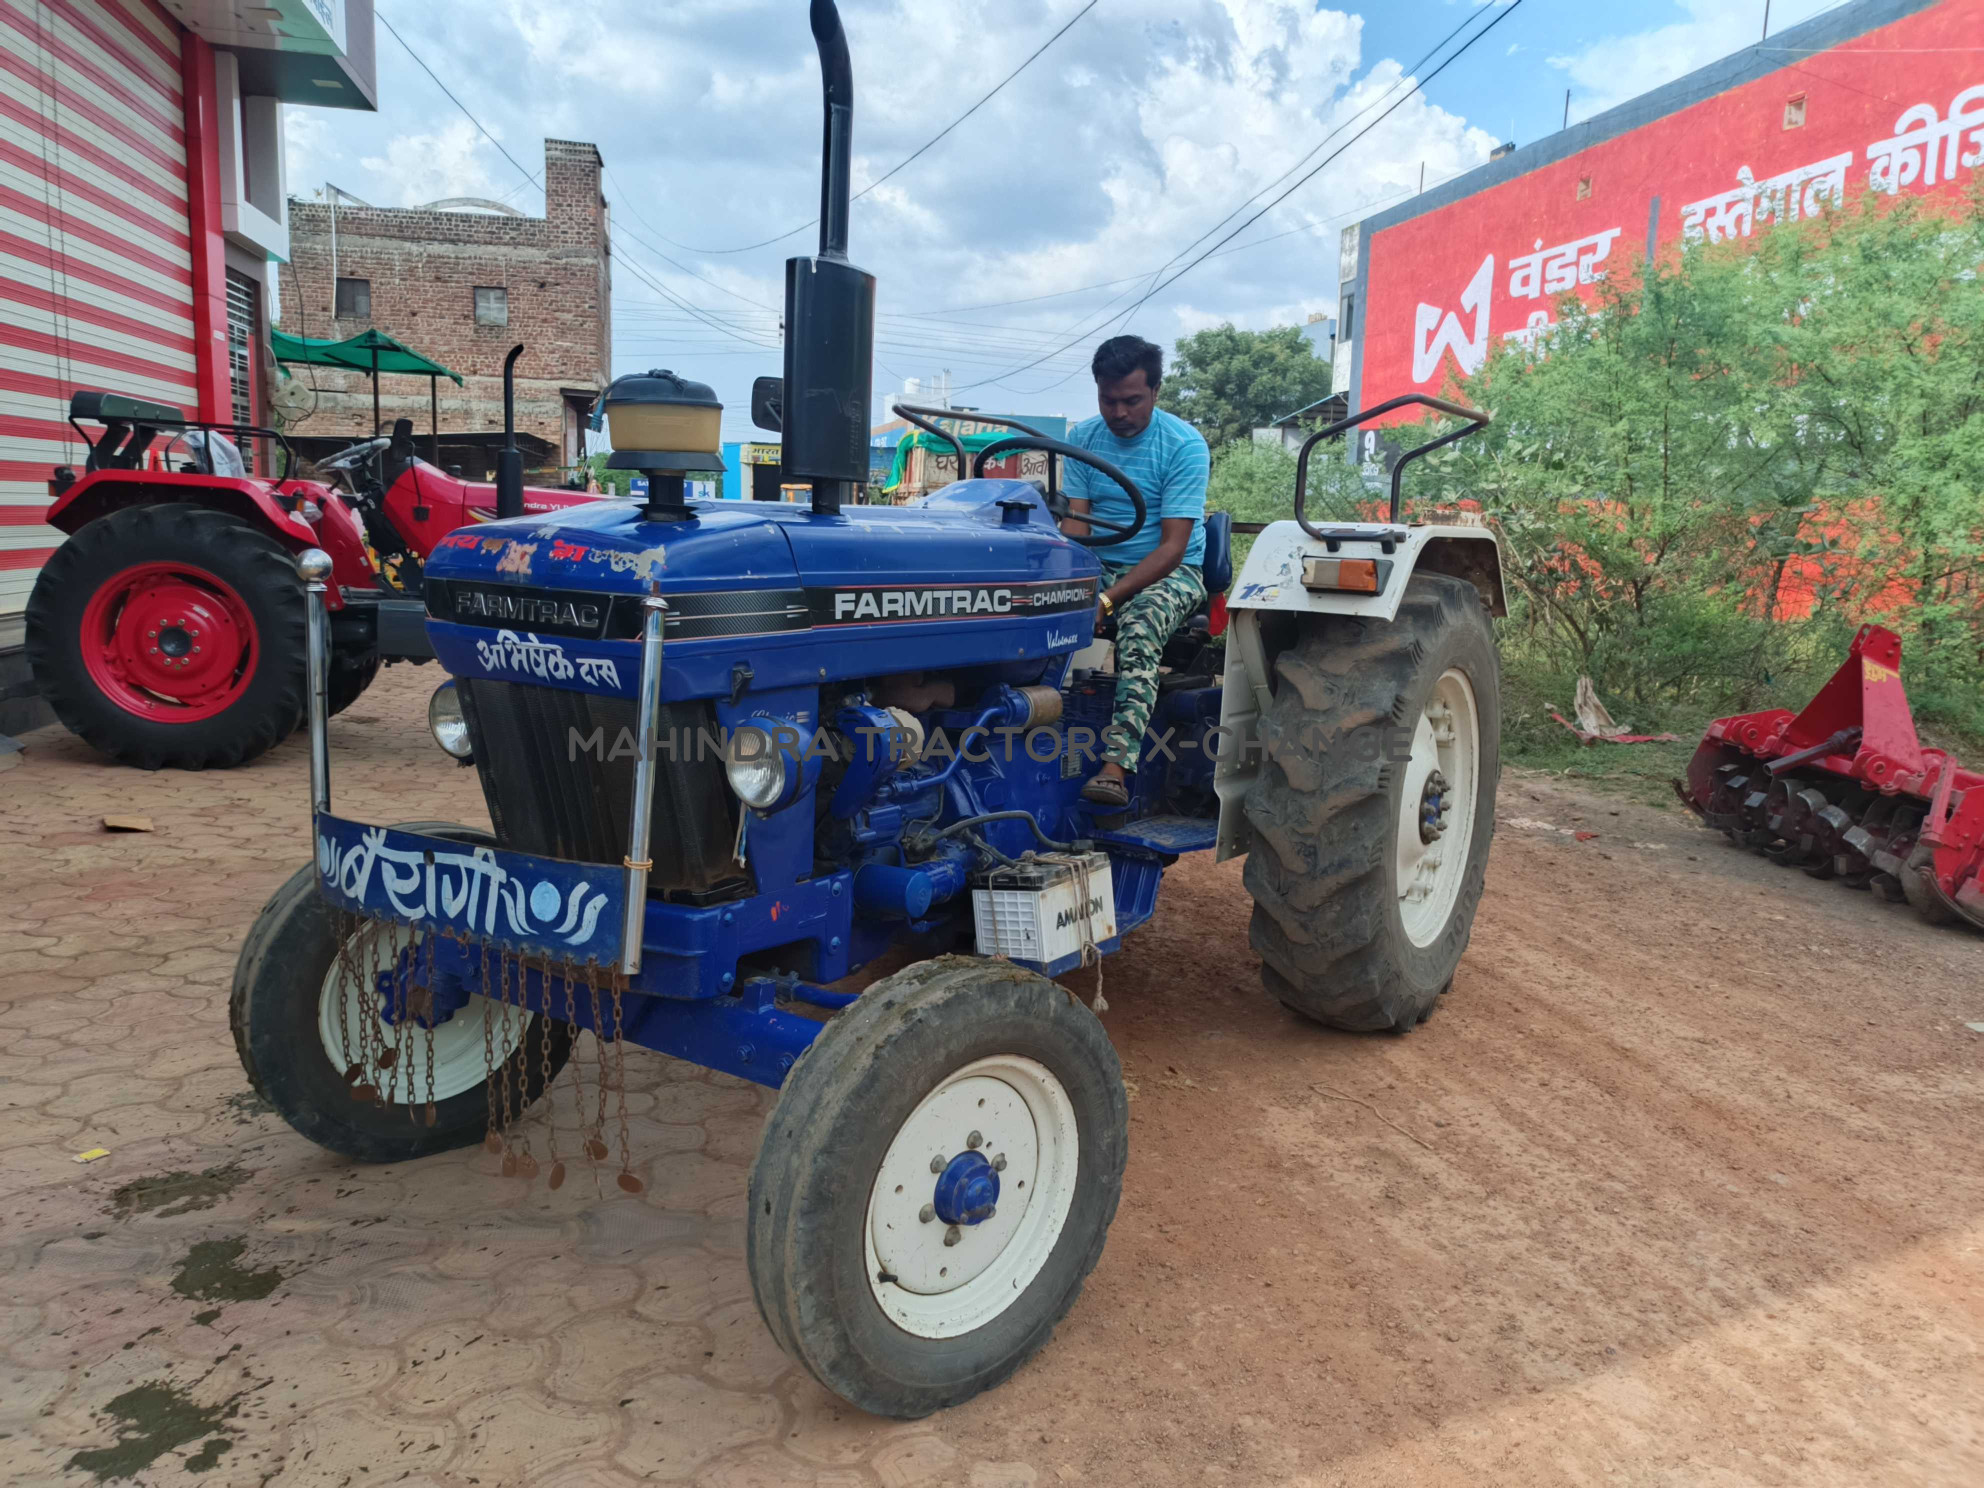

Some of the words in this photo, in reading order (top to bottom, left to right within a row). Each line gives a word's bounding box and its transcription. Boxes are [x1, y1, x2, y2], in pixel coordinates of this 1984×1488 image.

[1681, 151, 1853, 254] इस्तेमाल
[1508, 227, 1622, 300] वंडर
[1022, 453, 1049, 476] आवो
[455, 591, 599, 629] FARMTRAC
[835, 590, 1012, 620] FARMTRAC
[1033, 588, 1086, 607] CHAMPION
[476, 629, 575, 684] अभिषेक
[576, 657, 622, 690] दास
